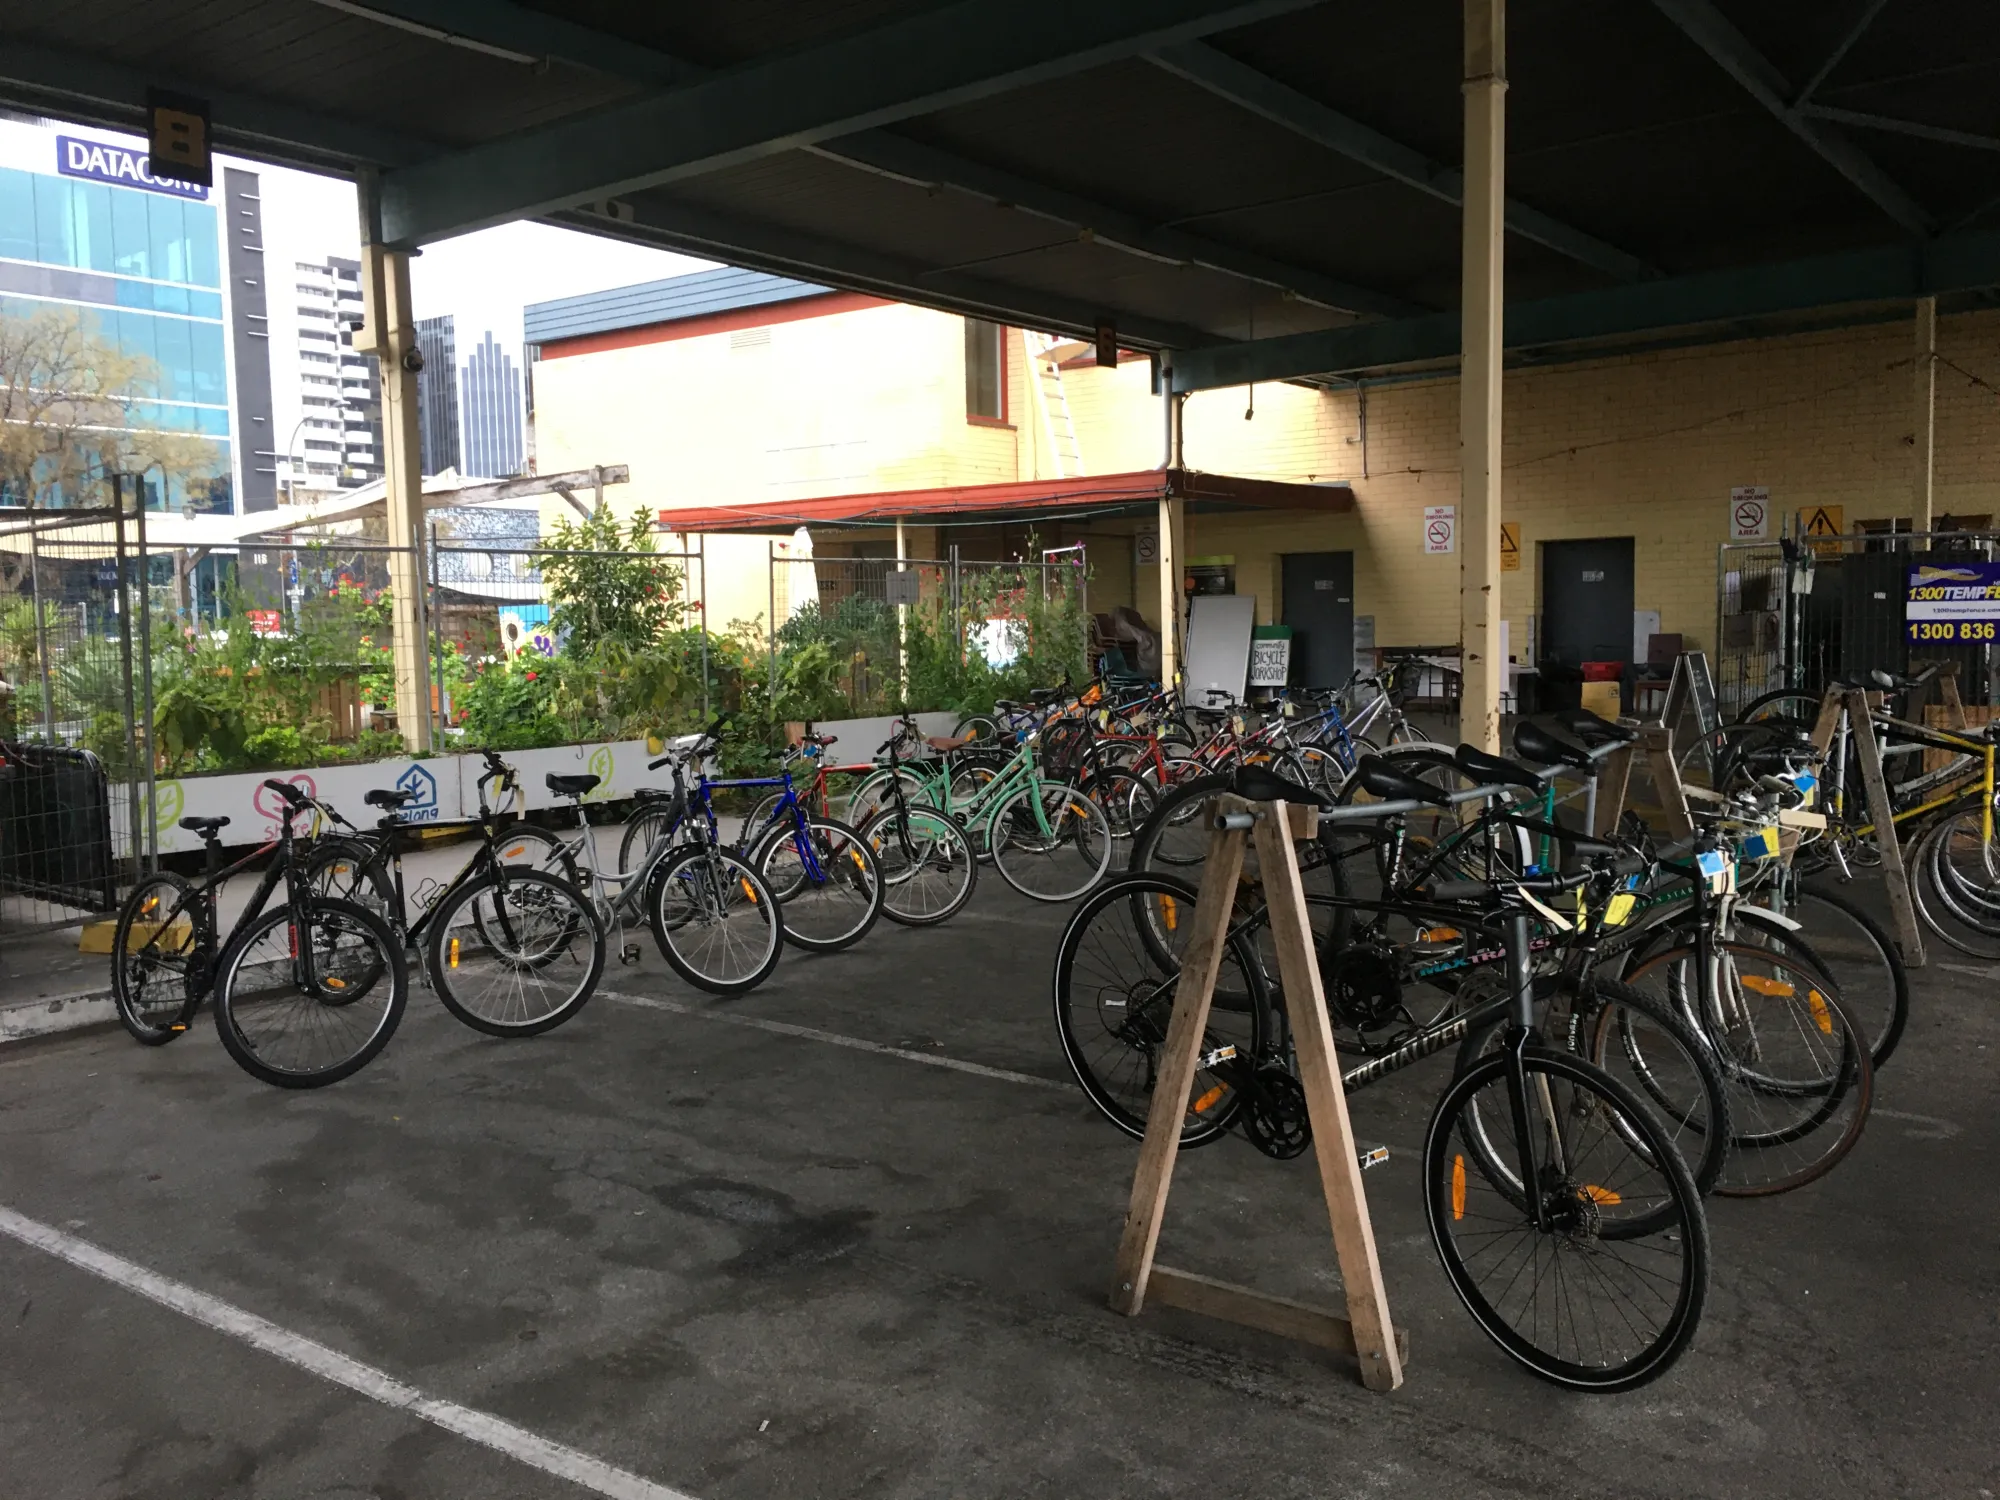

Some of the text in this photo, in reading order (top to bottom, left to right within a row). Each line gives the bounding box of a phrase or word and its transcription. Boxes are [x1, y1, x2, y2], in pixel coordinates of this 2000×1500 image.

[1909, 622, 1996, 640] 1300 836
[1252, 650, 1286, 666] BICYCLE
[398, 808, 439, 821] elong
[263, 823, 310, 841] shre
[1344, 1018, 1468, 1091] SPECIALIZED
